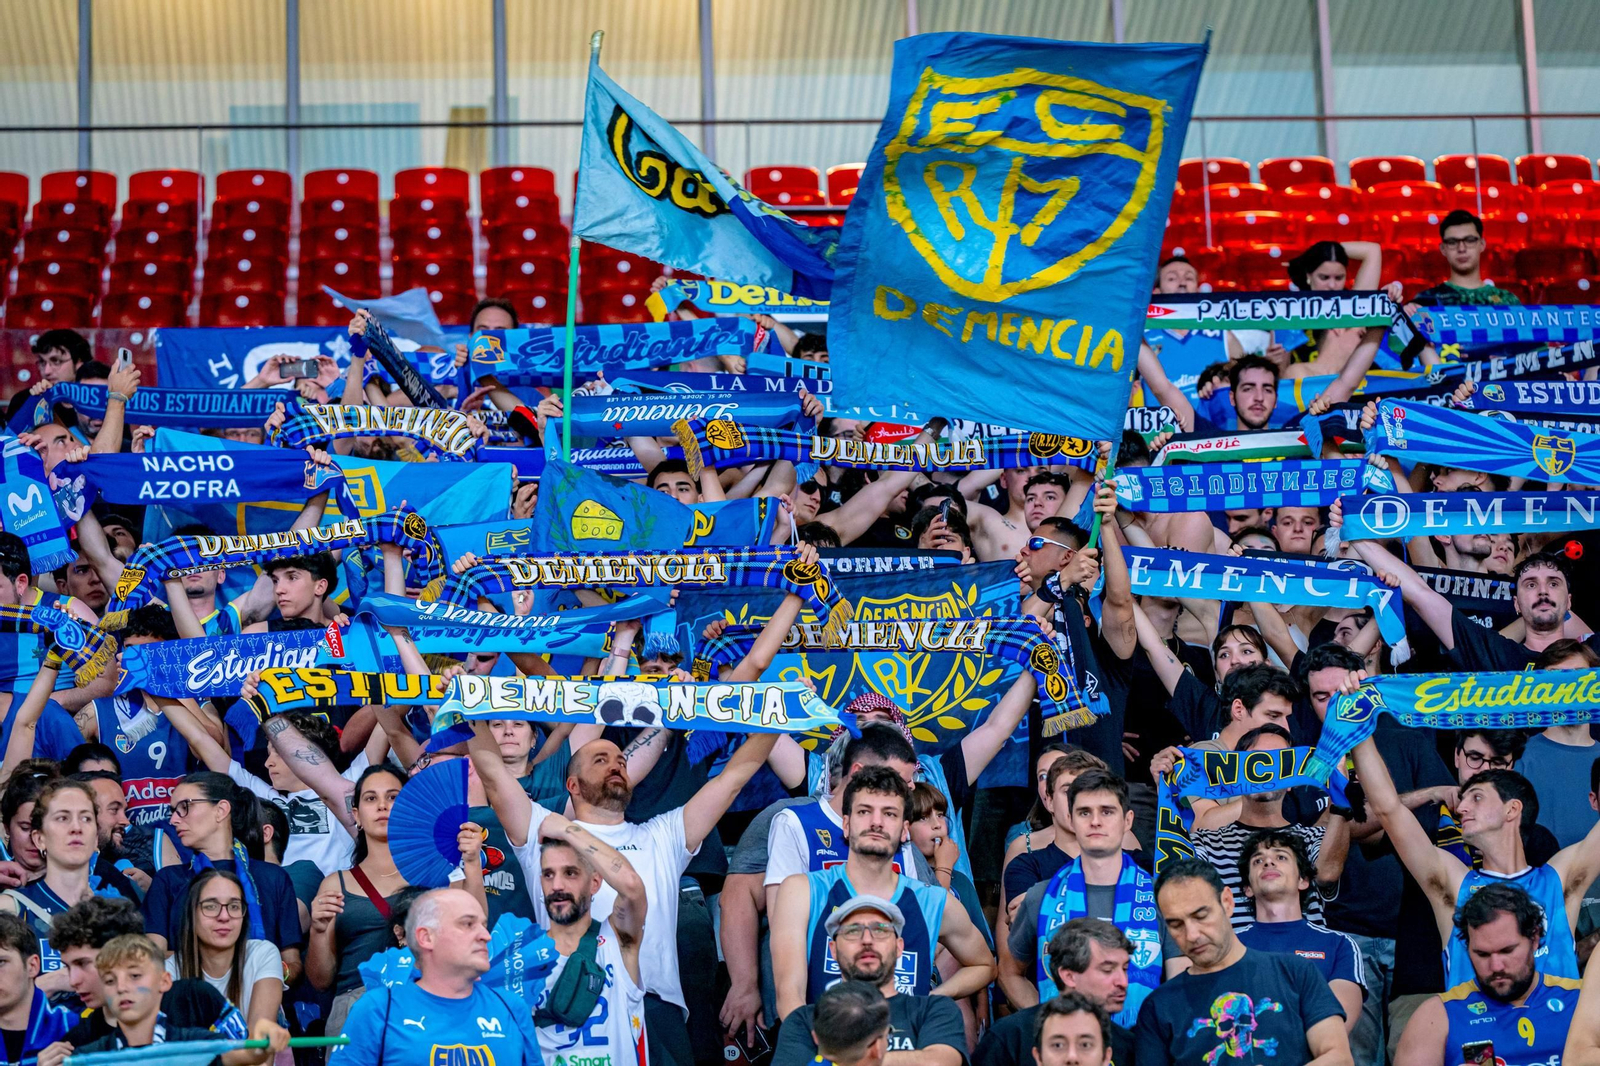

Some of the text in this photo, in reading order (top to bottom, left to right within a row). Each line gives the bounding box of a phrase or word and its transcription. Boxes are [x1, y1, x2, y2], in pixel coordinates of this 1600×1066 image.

[1197, 297, 1342, 321] PALESTINA
[1439, 310, 1600, 328] ESTUDIANTES
[872, 284, 1125, 373] DEMENCIA
[517, 330, 748, 373] Estudiantes
[711, 375, 747, 391] LA
[52, 382, 100, 406] TODOS
[164, 393, 288, 415] ESTUDIANTES
[601, 402, 740, 424] Demencia
[303, 404, 482, 454] DEMENCIA
[142, 455, 235, 473] NACHO
[811, 434, 987, 469] DEMENCIA
[138, 479, 241, 499] AZOFRA
[1371, 495, 1599, 530] DEMEN
[198, 519, 367, 558] DEMENCIA
[509, 555, 725, 586] DEMENCIA
[265, 666, 446, 704] ESTU
[148, 741, 167, 770] 9
[1204, 781, 1276, 797] RAMIRO
[1517, 1016, 1536, 1047] 9
[569, 1054, 612, 1066] Smart
[727, 1049, 737, 1058] 19
